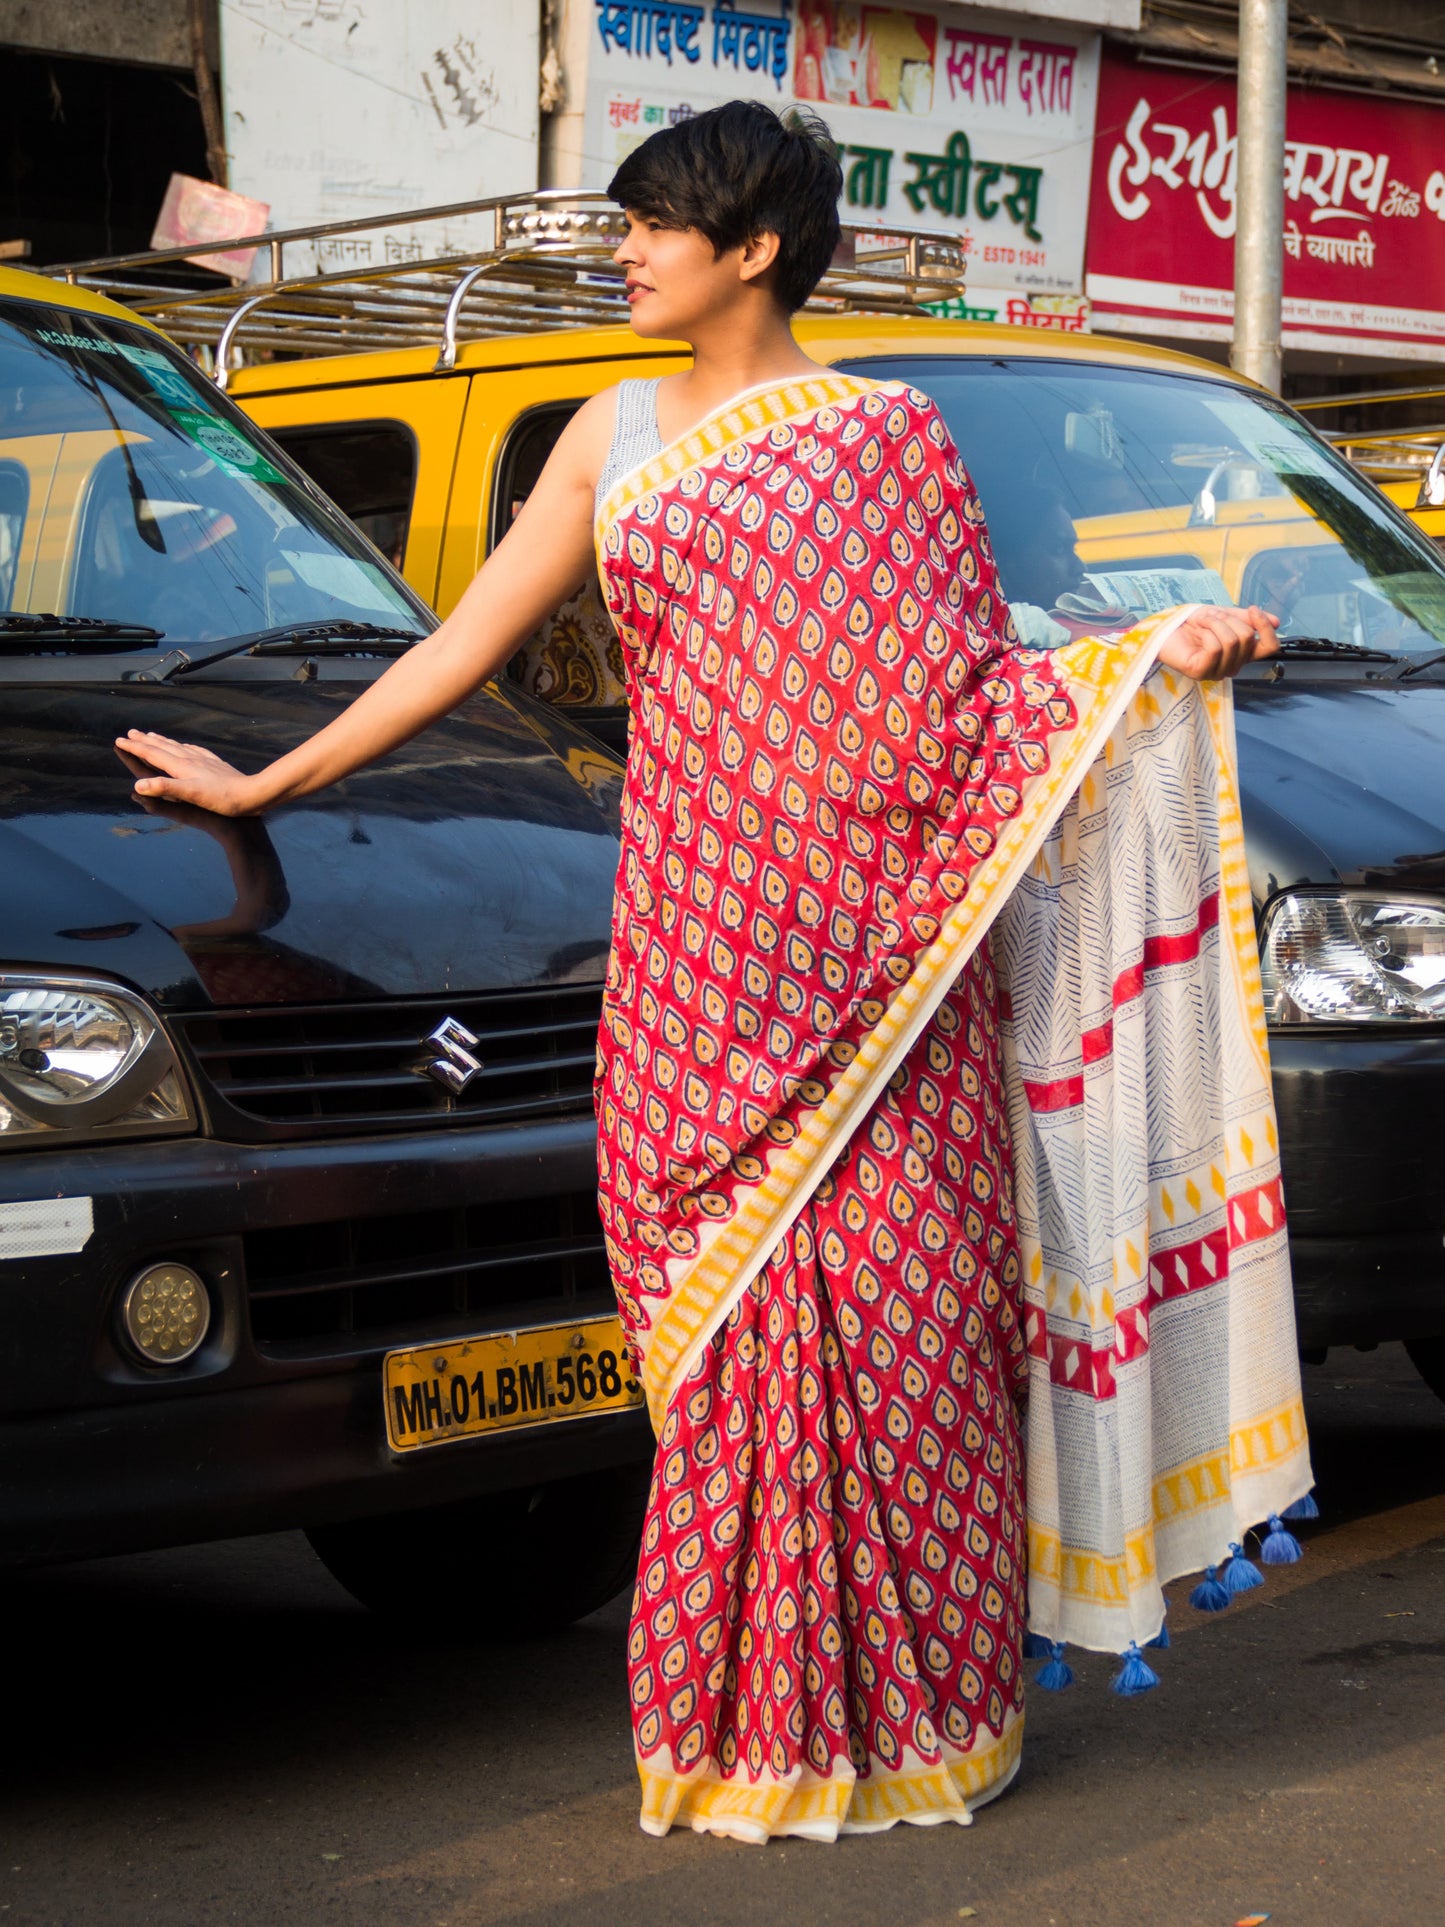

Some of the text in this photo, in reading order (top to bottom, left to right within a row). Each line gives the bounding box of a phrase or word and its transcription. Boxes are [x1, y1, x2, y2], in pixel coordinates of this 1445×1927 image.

[945, 27, 1077, 116] स्वस्त दरात
[608, 93, 642, 128] मुंबई
[643, 105, 664, 125] का
[984, 246, 1046, 267] ESTD 1941
[1306, 230, 1375, 267] व्यापारी
